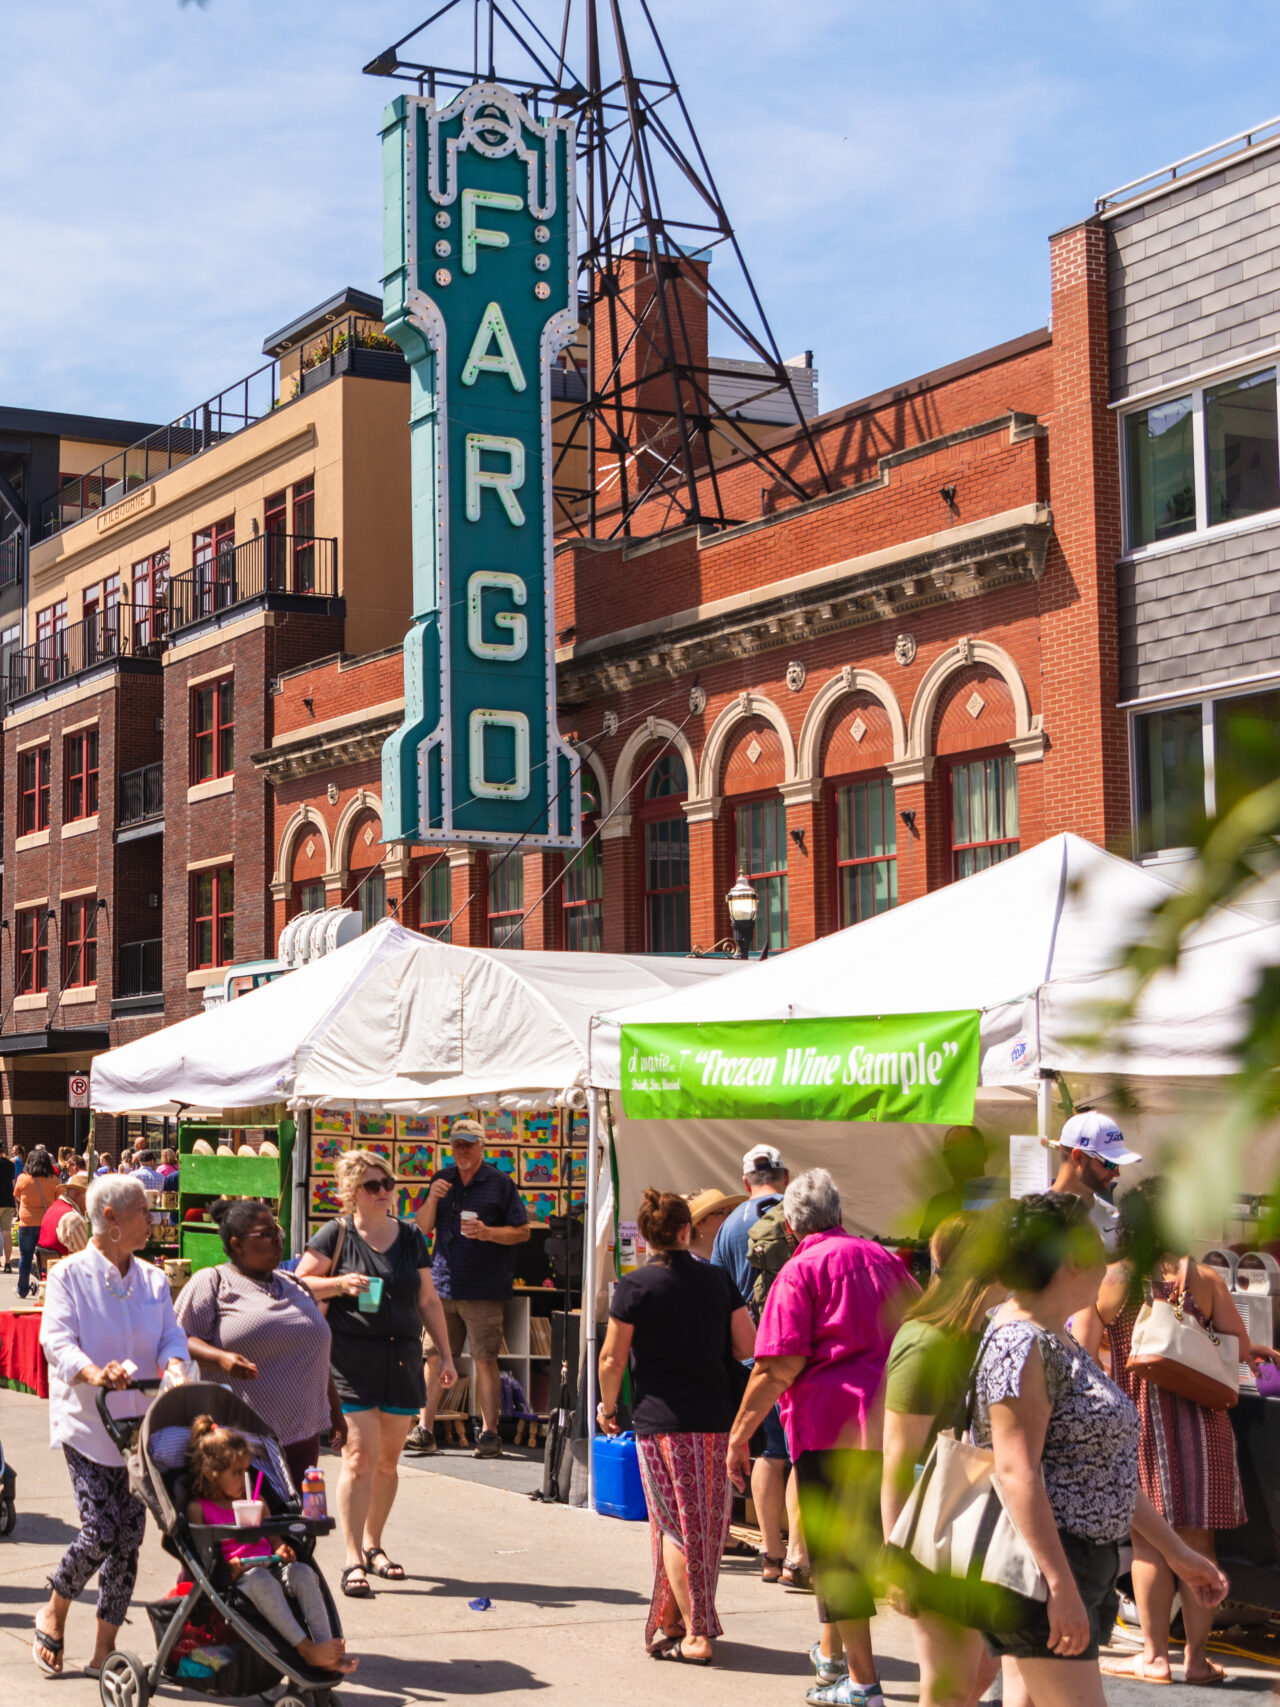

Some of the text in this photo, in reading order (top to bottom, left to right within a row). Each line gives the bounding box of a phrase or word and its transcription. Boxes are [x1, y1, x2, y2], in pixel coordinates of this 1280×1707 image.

[103, 492, 145, 527] KILBOURNE
[461, 188, 529, 801] FARGO
[781, 1046, 841, 1087] Wine
[1080, 1137, 1090, 1147] FJ
